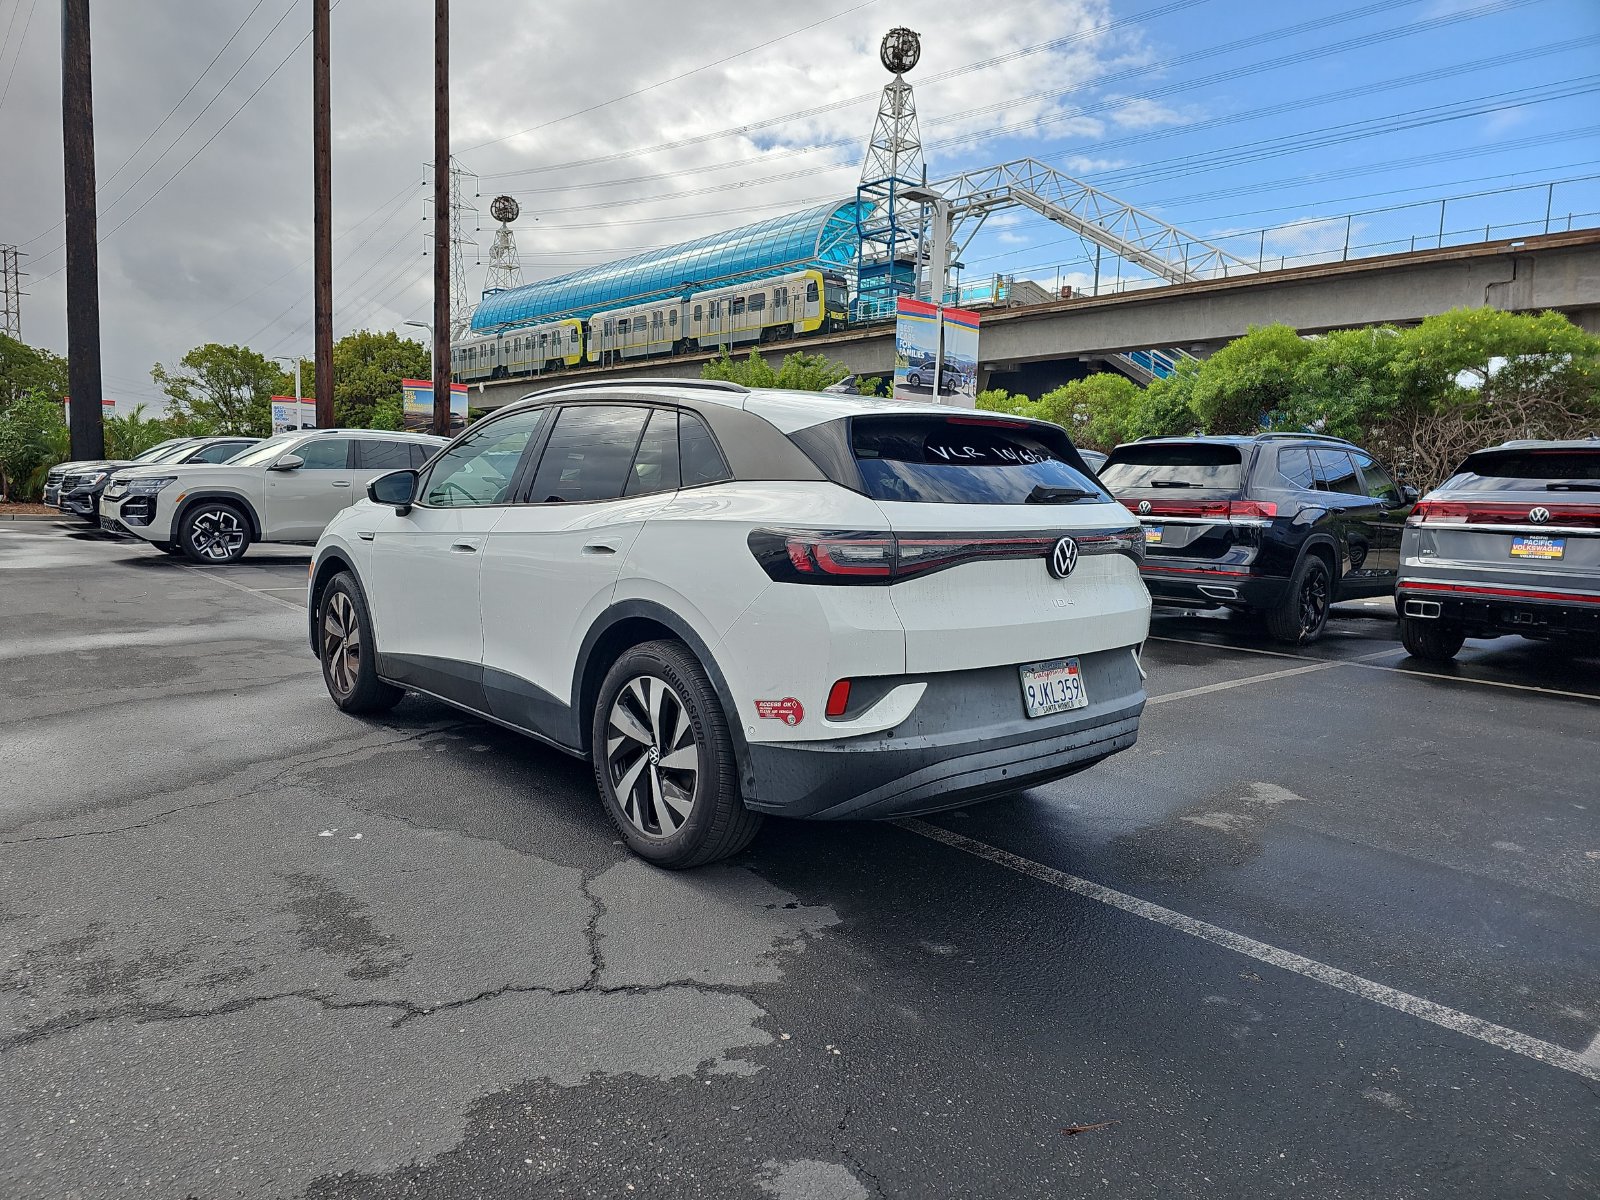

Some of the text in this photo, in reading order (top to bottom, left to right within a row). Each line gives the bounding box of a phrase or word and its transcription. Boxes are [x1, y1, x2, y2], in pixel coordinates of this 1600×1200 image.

[899, 323, 913, 334] BEST
[899, 332, 916, 341] CARS
[899, 340, 912, 349] FOR
[898, 348, 925, 359] FAMILIES
[927, 445, 986, 461] VLR
[1513, 544, 1563, 552] VOLKSWAGEN
[1027, 677, 1079, 708] 9JKL359
[661, 663, 707, 750] BRIDGESTONE
[1042, 704, 1057, 713] SANTA
